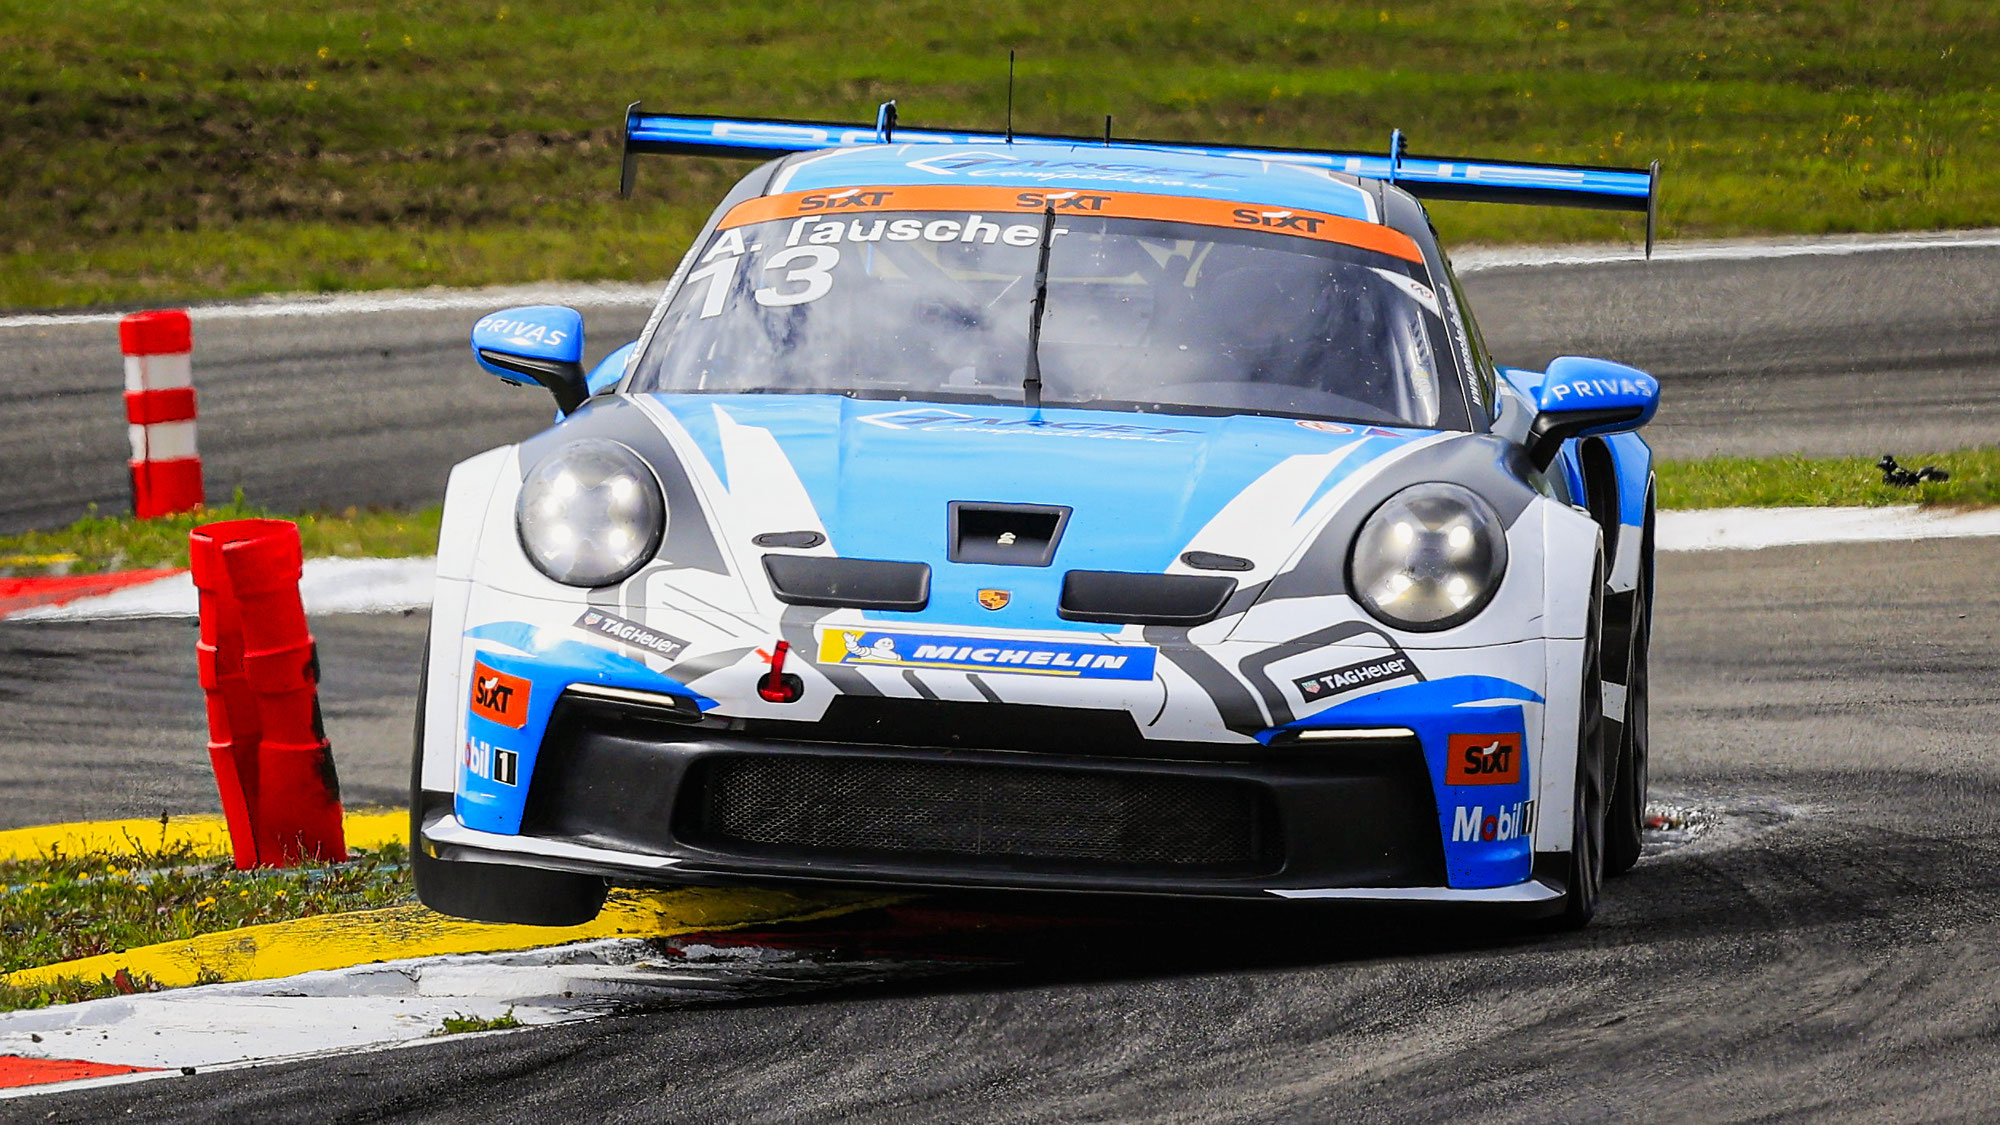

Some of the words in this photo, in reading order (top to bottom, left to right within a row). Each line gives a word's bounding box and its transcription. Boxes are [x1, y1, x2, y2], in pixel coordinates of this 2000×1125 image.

[701, 227, 763, 263] A.
[785, 214, 1069, 249] Tauscher
[687, 244, 840, 320] 13
[473, 319, 568, 346] PRIVAS
[1551, 378, 1653, 401] PRIVAS
[912, 645, 1128, 670] MICHELIN
[463, 735, 491, 780] obil
[1452, 802, 1522, 842] Mobil
